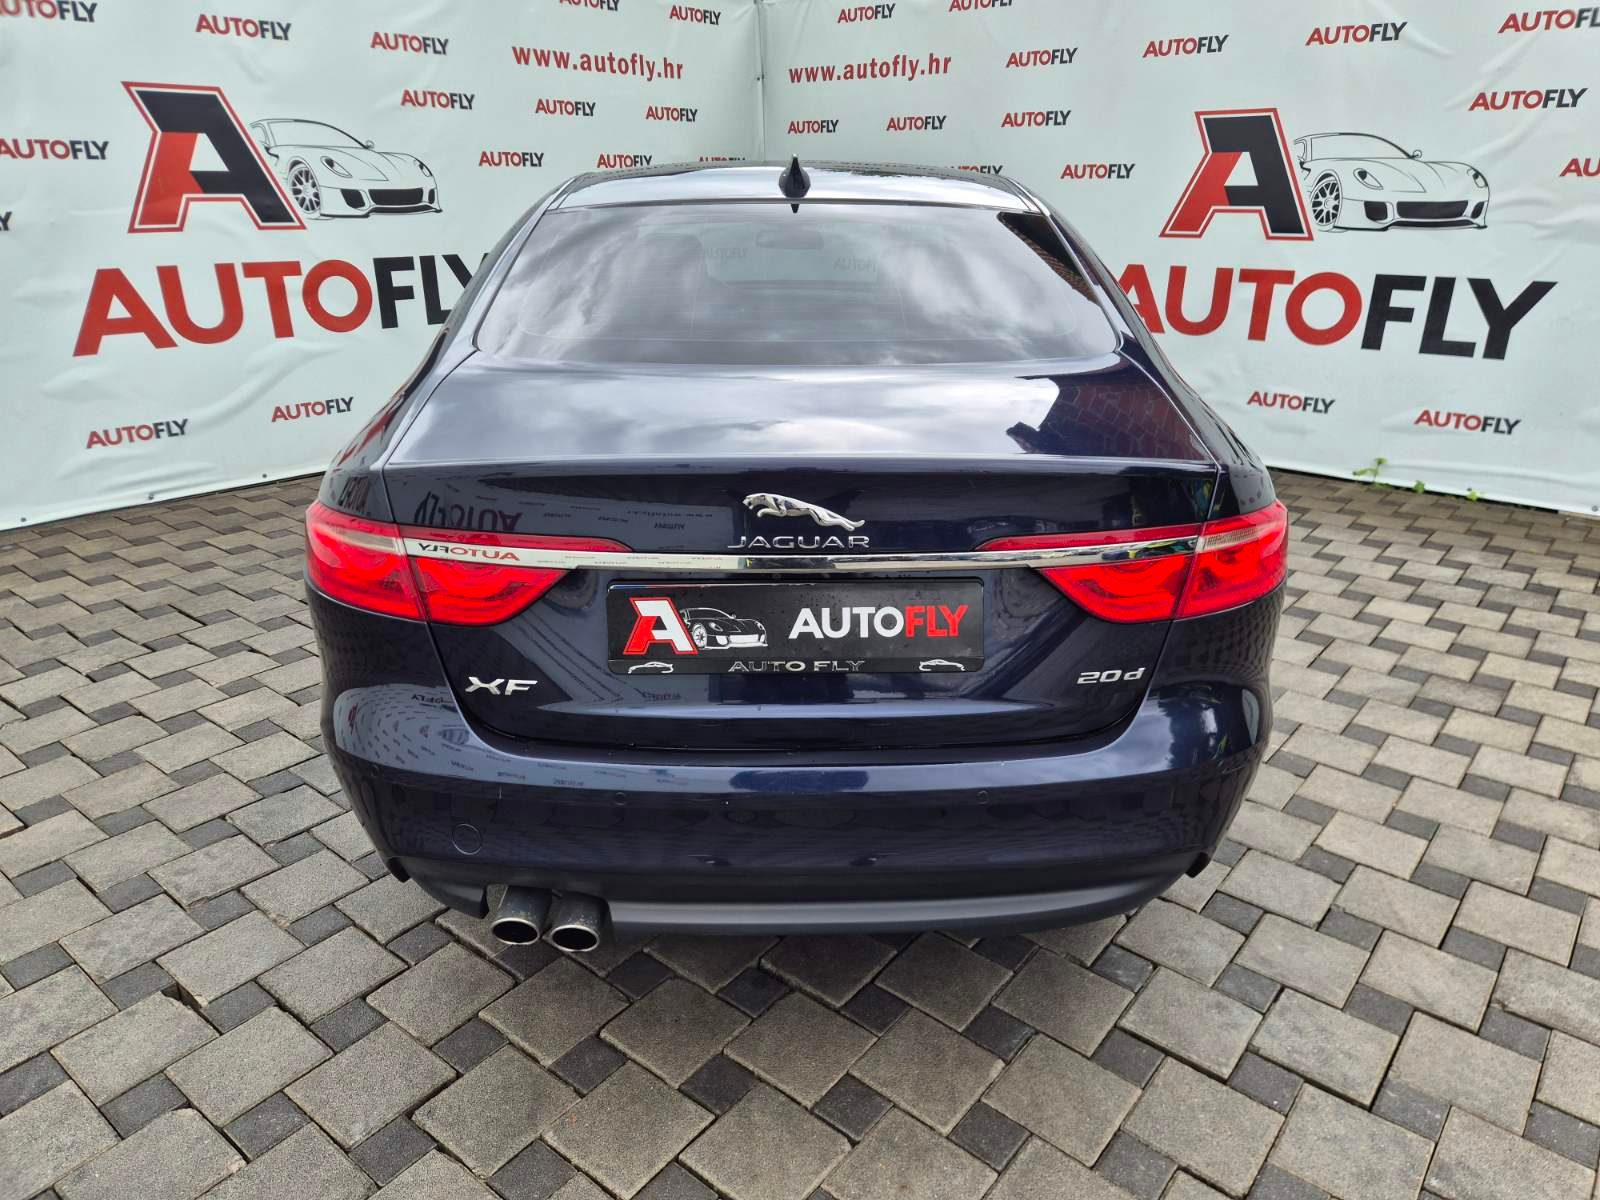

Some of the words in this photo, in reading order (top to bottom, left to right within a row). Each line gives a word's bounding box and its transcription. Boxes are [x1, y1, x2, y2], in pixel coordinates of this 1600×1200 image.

[0, 0, 98, 22] UTOFLY
[669, 5, 721, 25] AUTOFLY
[837, 3, 896, 24] AUTOFLY
[196, 14, 292, 41] AUTOFLY
[1306, 22, 1408, 46] AUTOFLY
[371, 31, 449, 55] AUTOFLY
[1143, 34, 1229, 58] AUTOFLY
[512, 46, 683, 82] www.autofly.hr
[1006, 47, 1078, 68] AUTOFLY
[788, 53, 952, 84] www.autofly.hr
[401, 89, 475, 110] AUTOFLY
[535, 98, 596, 117] AUTOFLY
[1468, 87, 1588, 111] AUTOFLY
[645, 106, 698, 123] AUTOFLY
[886, 115, 947, 132] AUTOFLY
[1001, 110, 1072, 128] AUTOFLY
[787, 119, 840, 135] AUTOFLY
[0, 138, 109, 160] AUTOFLY
[478, 151, 545, 168] AUTOFLY
[1060, 163, 1136, 180] AUTOFLY
[1119, 264, 1558, 361] AUTOFLY
[271, 396, 354, 422] AUTOFLY
[1247, 391, 1335, 414] AUTOFLY
[1414, 409, 1521, 435] AUTOFLY
[86, 418, 188, 449] AUTOFLY
[727, 535, 870, 549] JAGUAR
[789, 604, 969, 640] AUTOFLY
[728, 660, 806, 672] AUTO
[813, 660, 865, 672] FLY
[1077, 667, 1146, 685] 20d
[465, 676, 538, 696] XF
